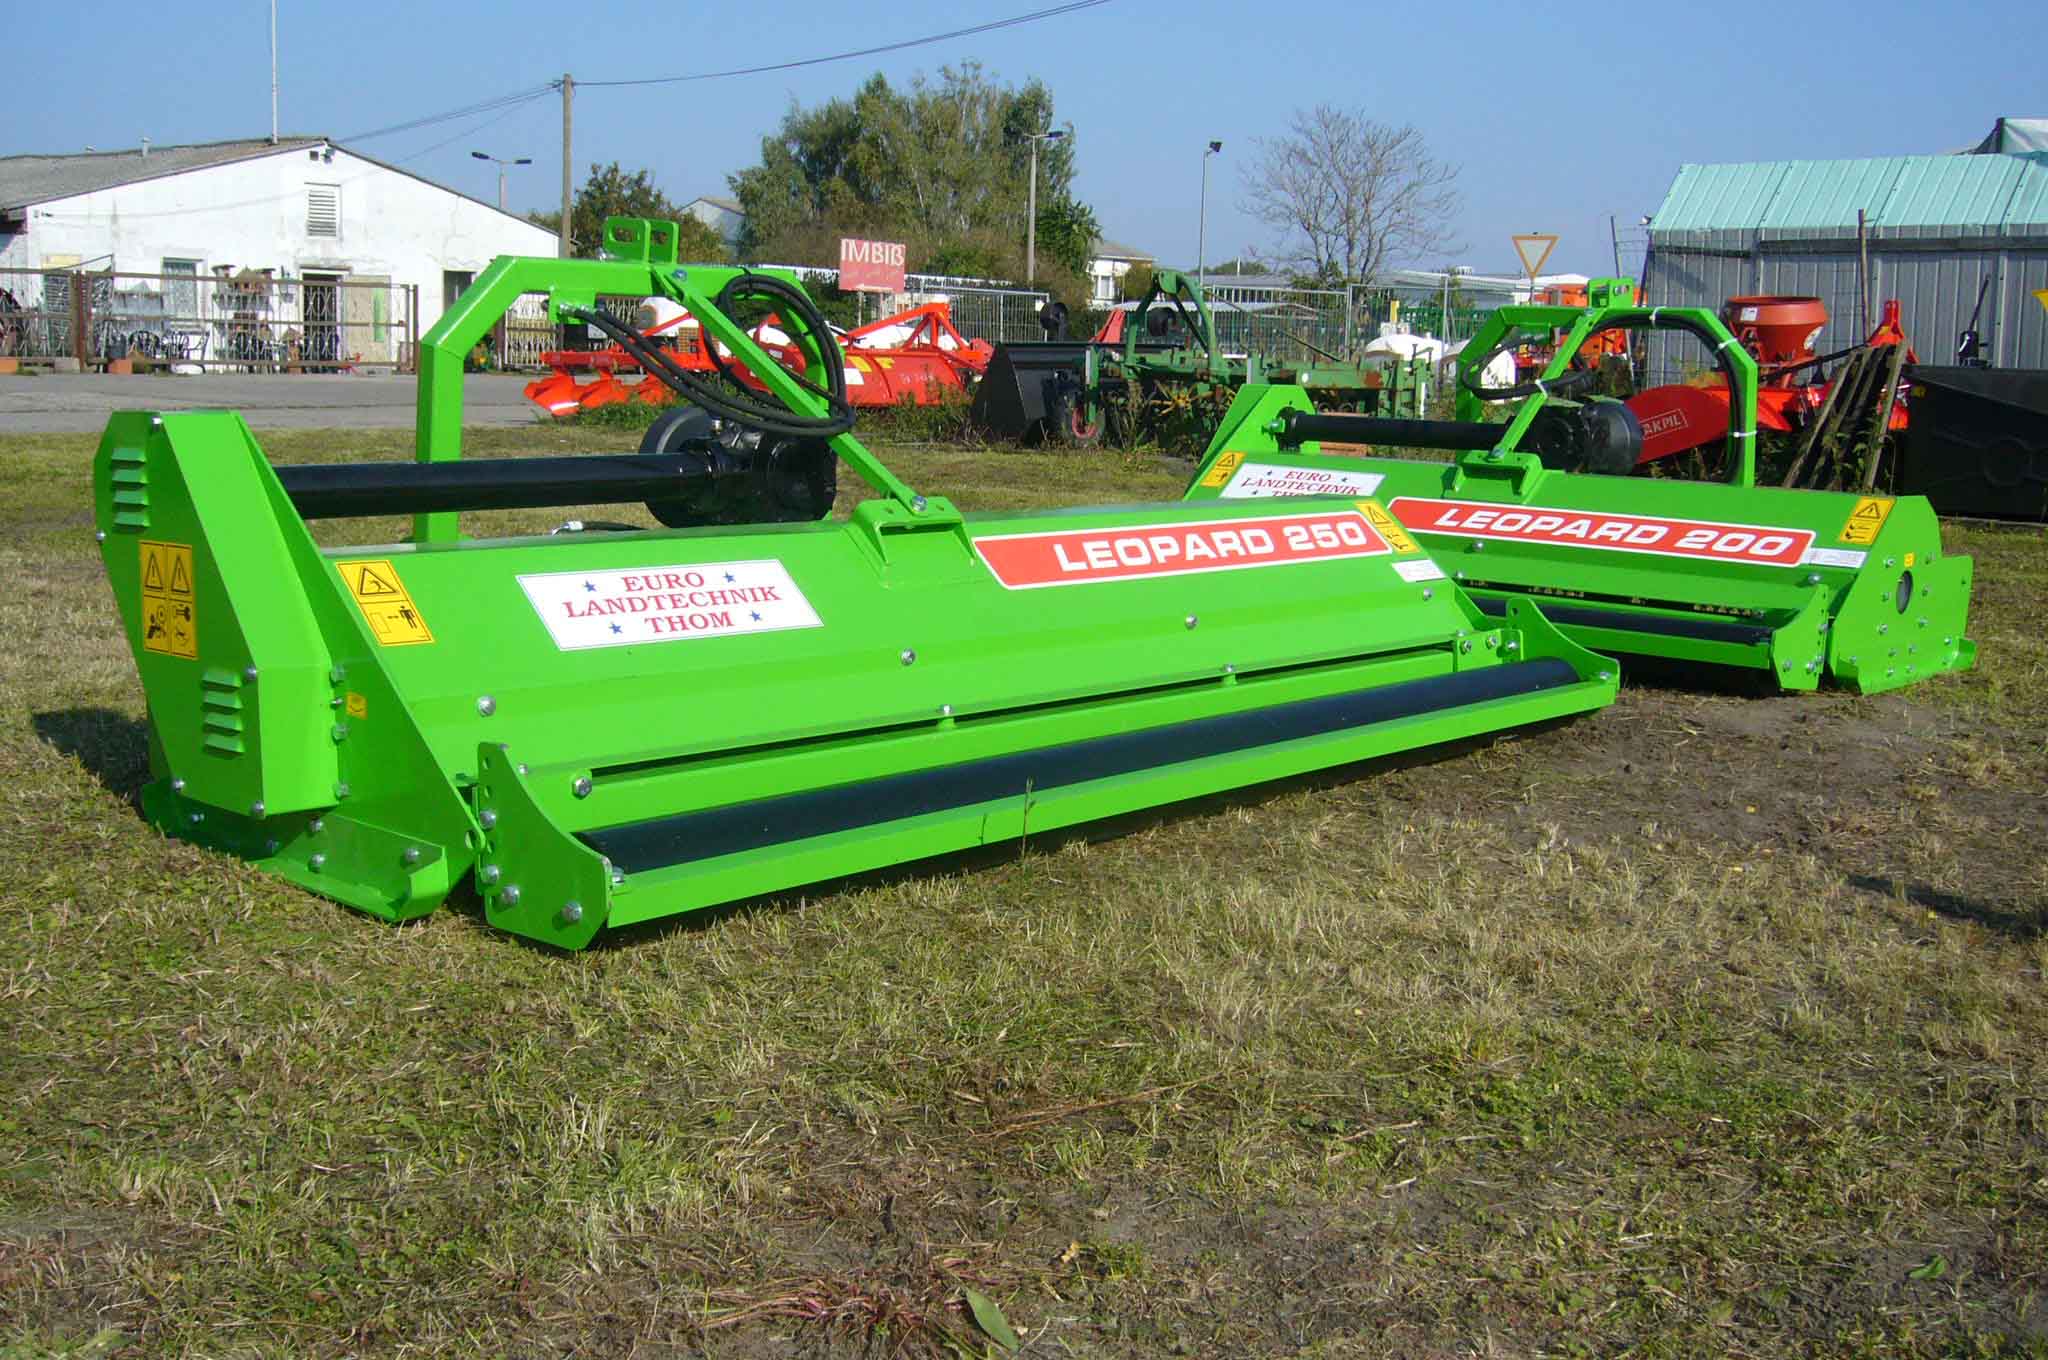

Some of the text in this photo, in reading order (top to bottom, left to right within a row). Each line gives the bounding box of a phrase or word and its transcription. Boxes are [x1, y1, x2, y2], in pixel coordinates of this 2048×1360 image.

[1241, 477, 1360, 495] LANDTECHNIK
[1285, 471, 1331, 482] EURO
[1435, 509, 1793, 556] LEOPARD 200
[1054, 520, 1368, 572] LEOPARD 250
[621, 572, 705, 593] EURO
[562, 586, 782, 618] LANDTECHNIK
[644, 611, 735, 634] THOM
